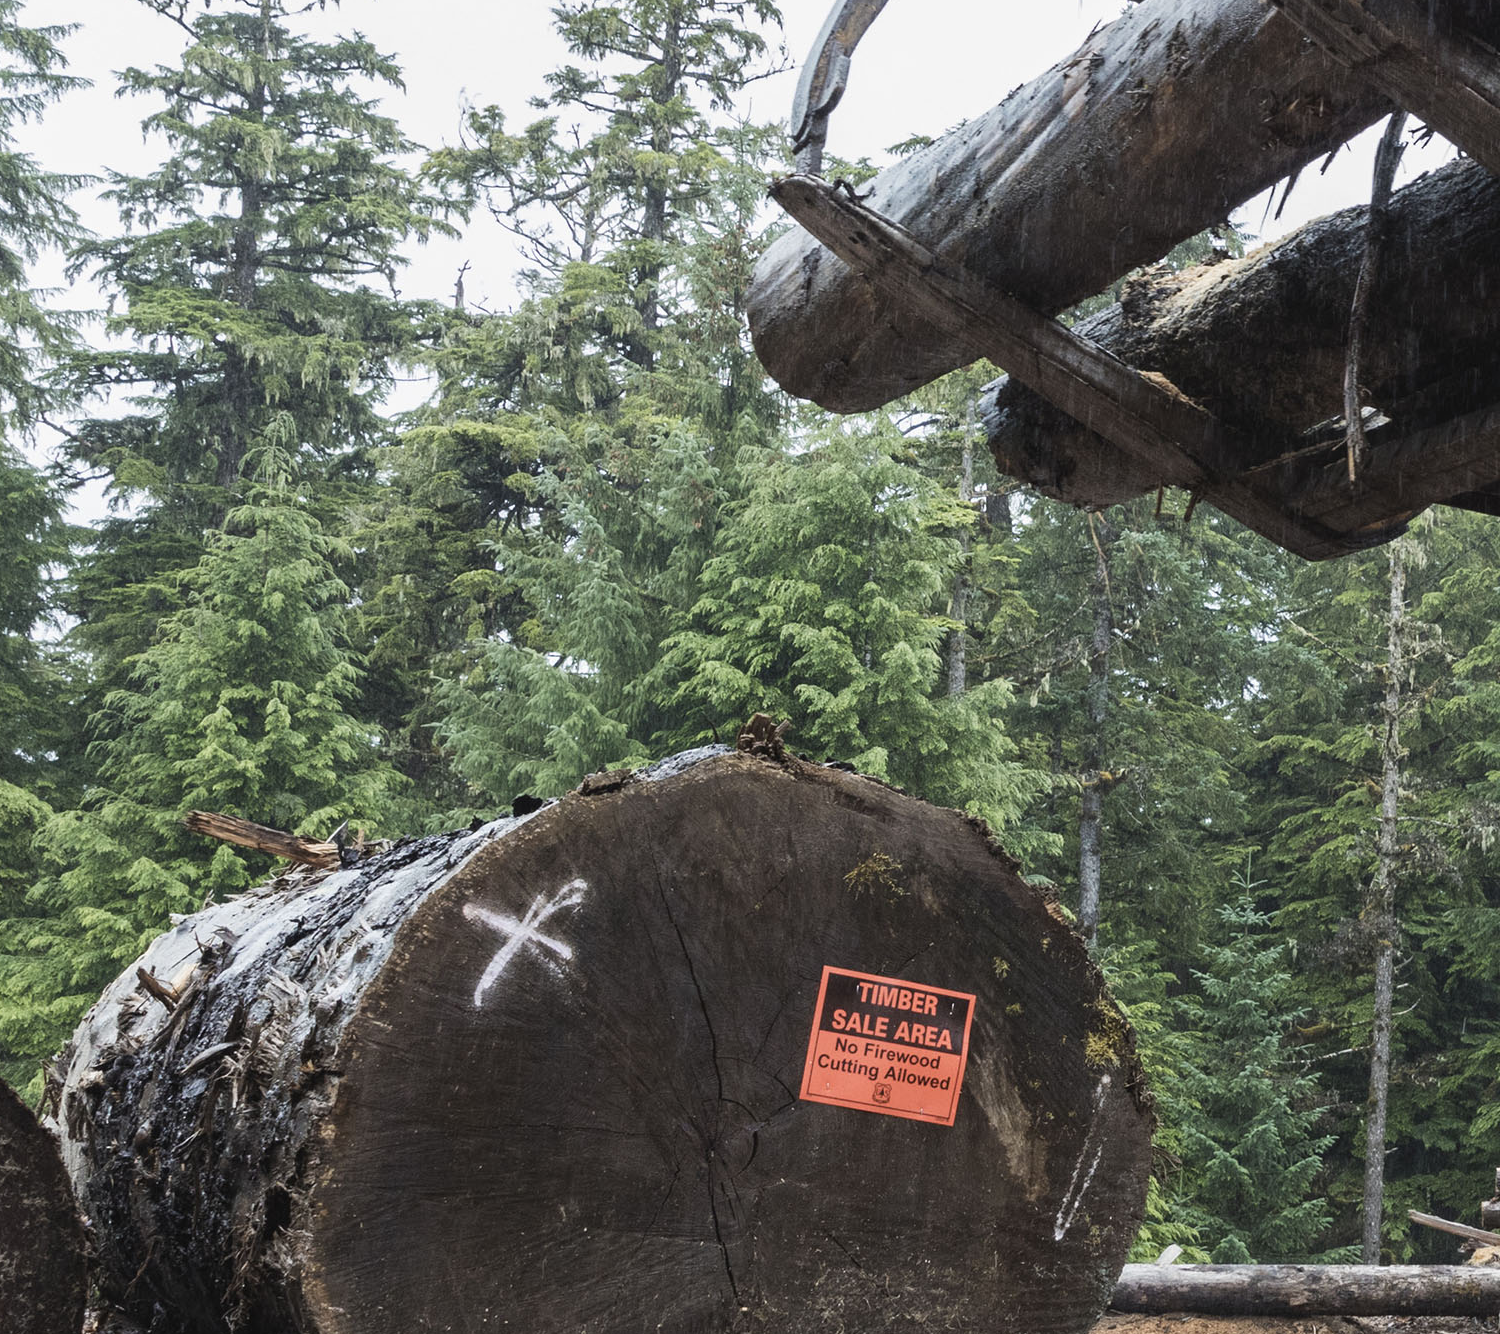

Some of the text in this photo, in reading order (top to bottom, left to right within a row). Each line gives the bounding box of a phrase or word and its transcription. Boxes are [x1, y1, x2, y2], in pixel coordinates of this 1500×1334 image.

[858, 981, 938, 1016] TIMBER
[831, 1008, 953, 1051] SALE AREA
[835, 1037, 941, 1070] No Firewood
[817, 1053, 951, 1091] Cutting Allowed
